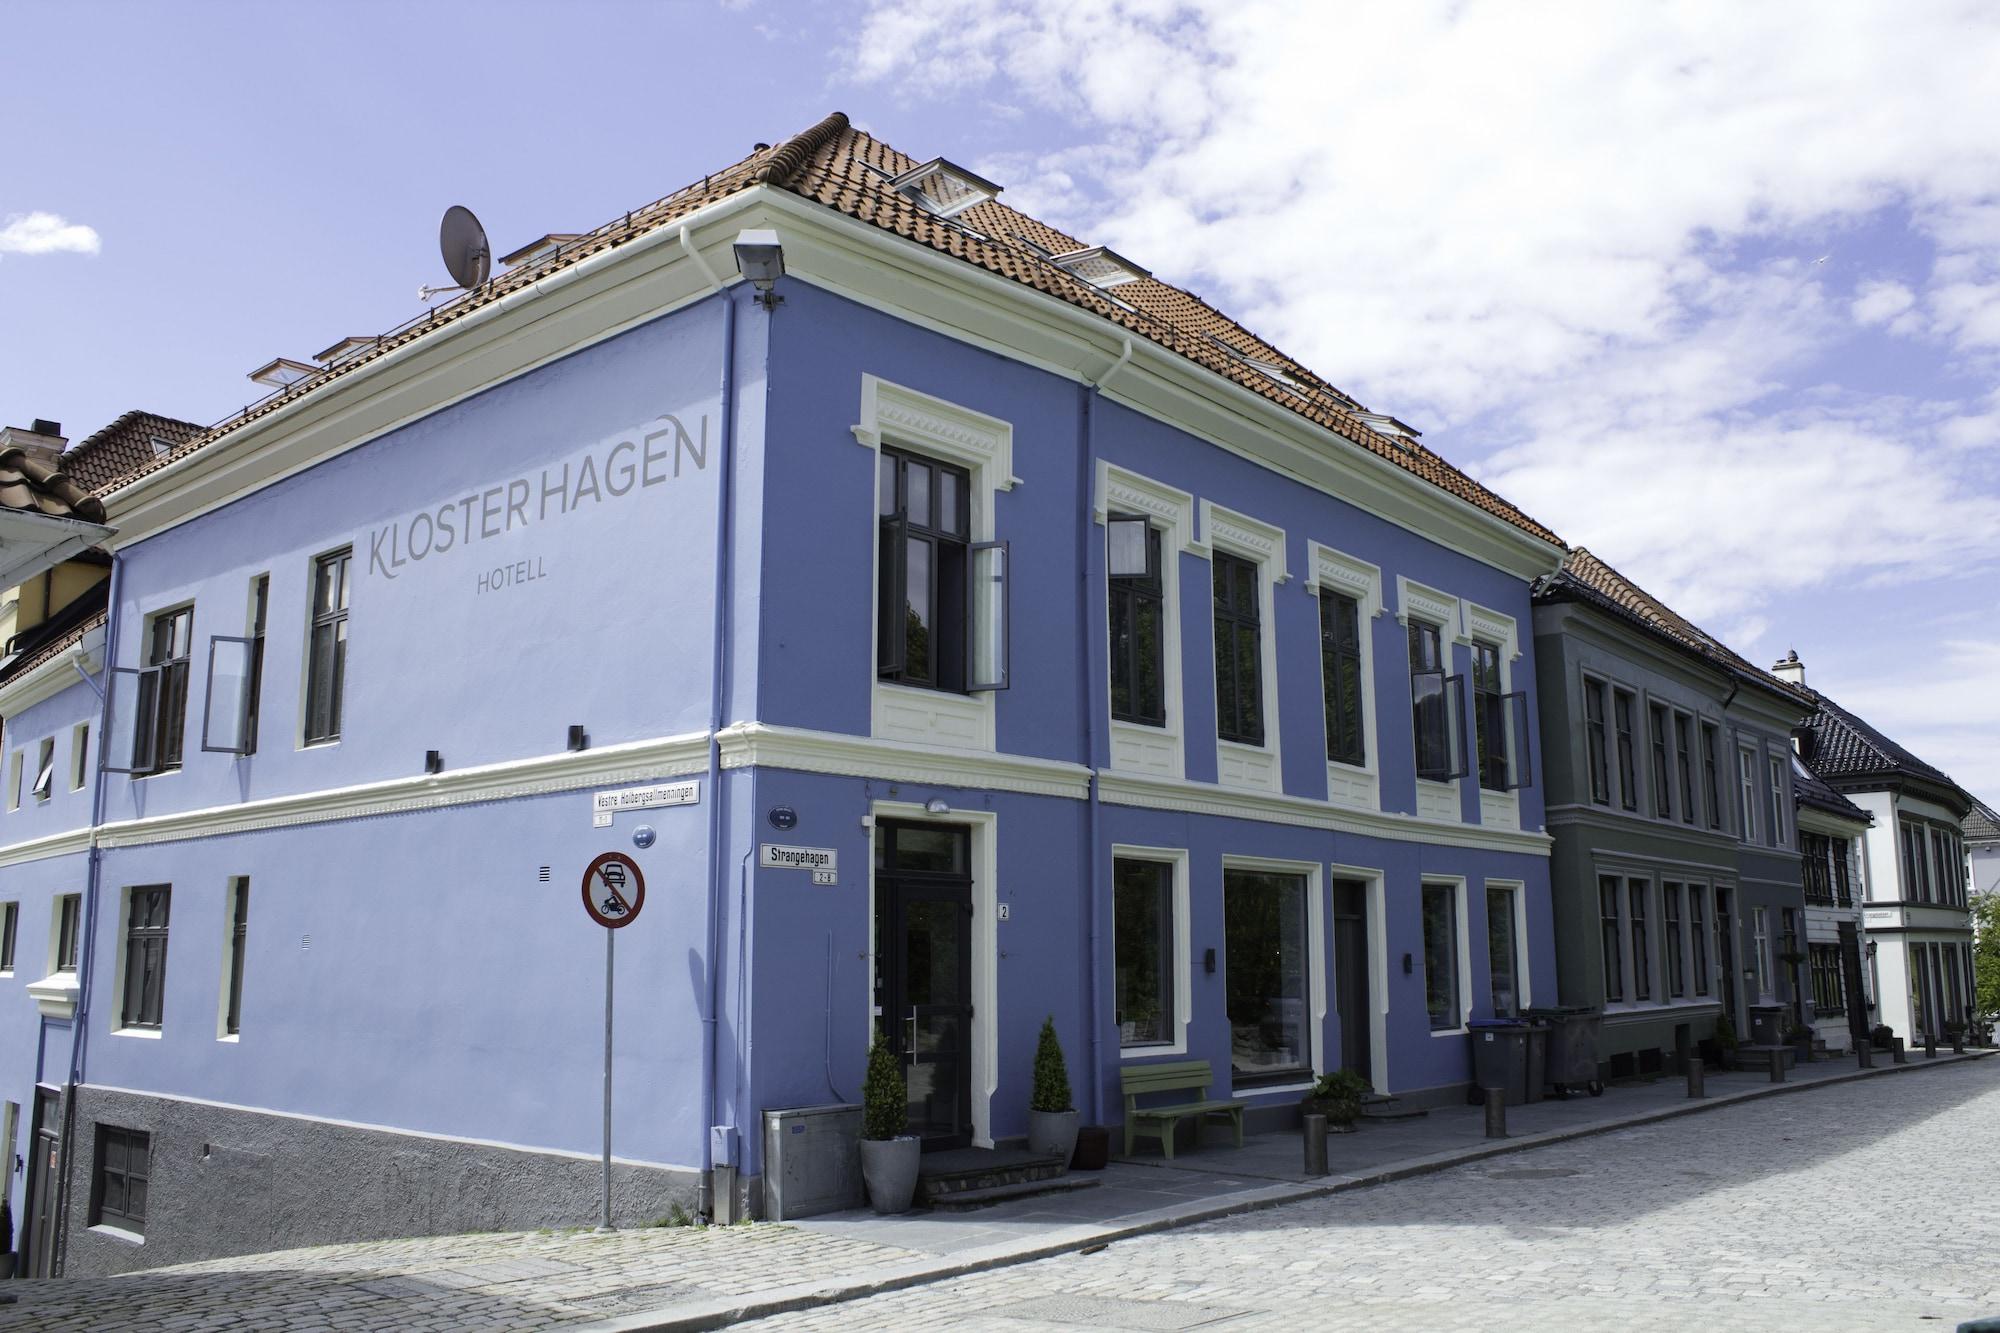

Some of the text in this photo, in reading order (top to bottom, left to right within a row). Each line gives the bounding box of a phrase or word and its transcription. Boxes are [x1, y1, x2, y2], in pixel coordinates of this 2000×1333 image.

[369, 414, 707, 579] KLOSTERHAGEN
[478, 556, 546, 595] HOTELL
[598, 794, 618, 807] Vestre
[771, 847, 829, 867] Strangehagen
[1002, 906, 1007, 918] 2
